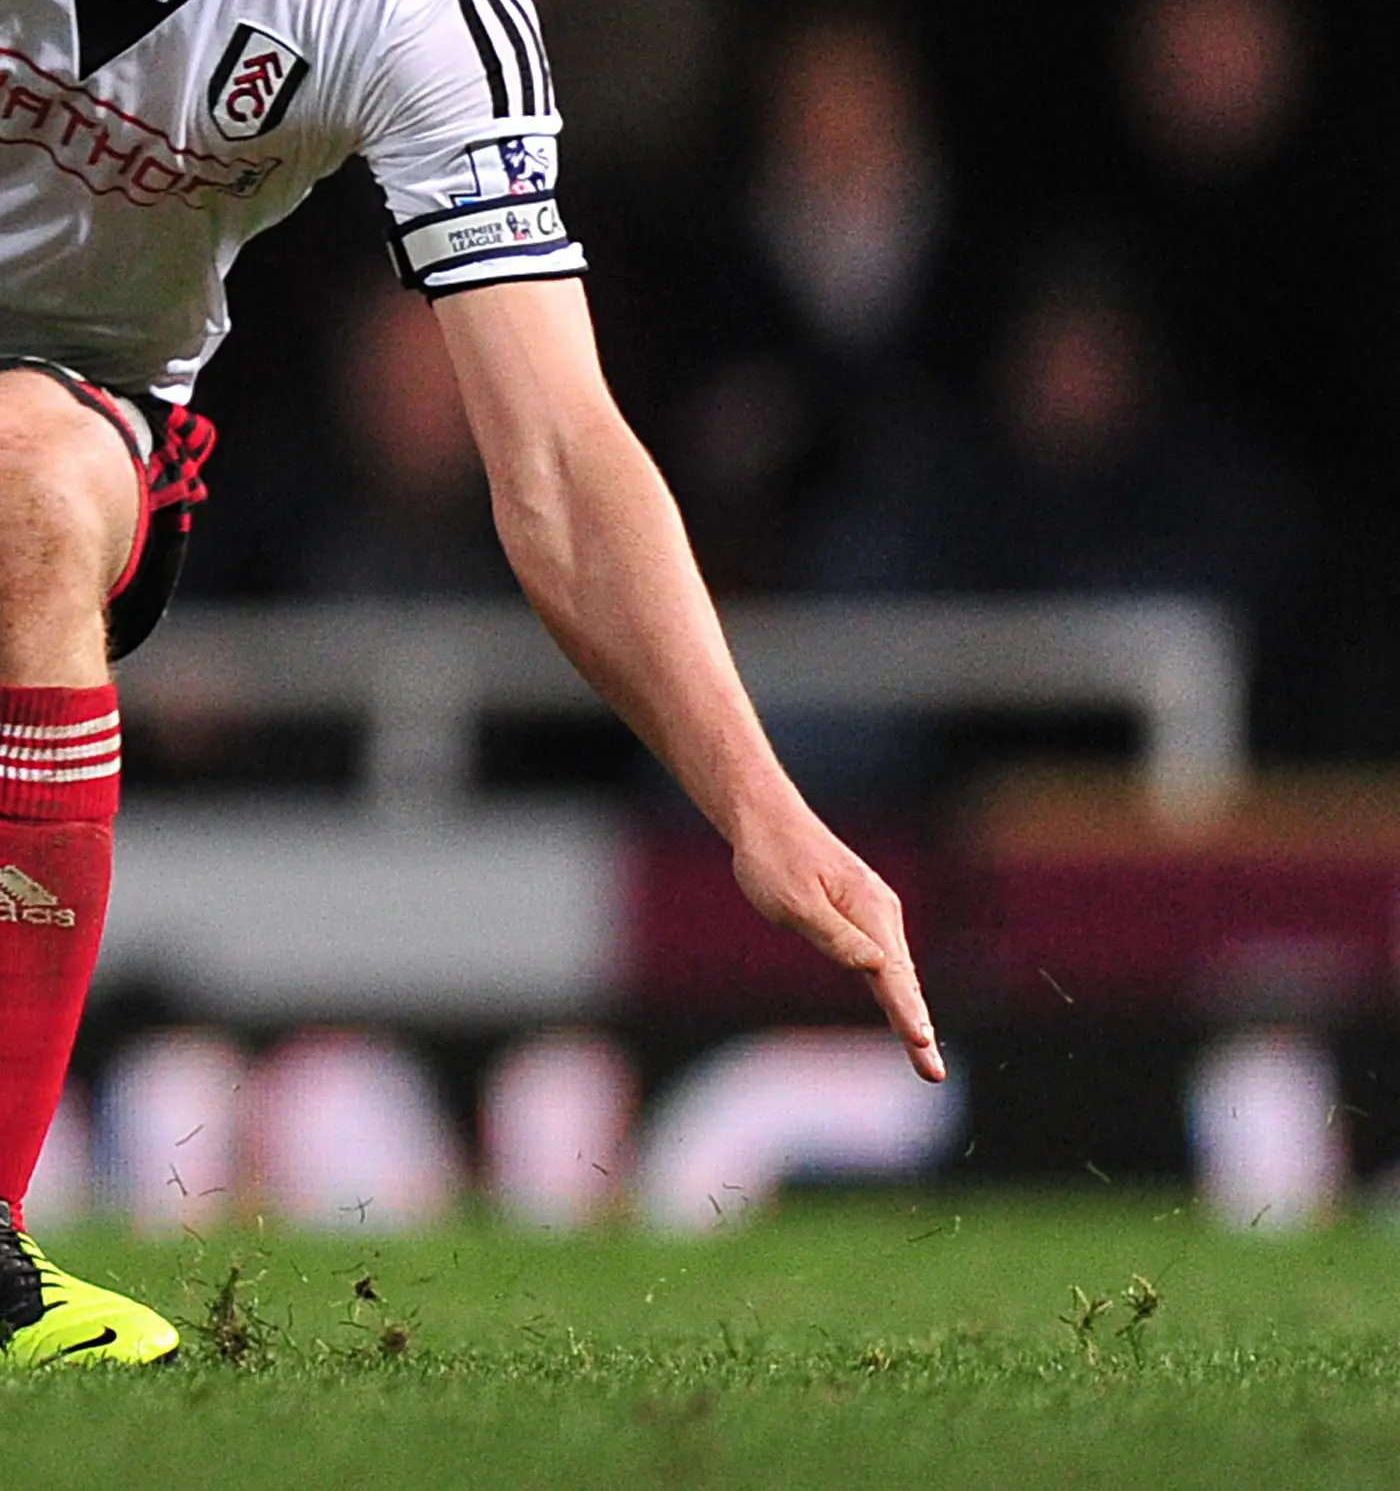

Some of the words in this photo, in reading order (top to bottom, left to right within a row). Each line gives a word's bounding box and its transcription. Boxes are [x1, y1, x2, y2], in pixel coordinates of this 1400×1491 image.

[226, 51, 283, 123] FFC
[449, 222, 503, 243] PREMIER
[452, 235, 504, 253] LEAGUE
